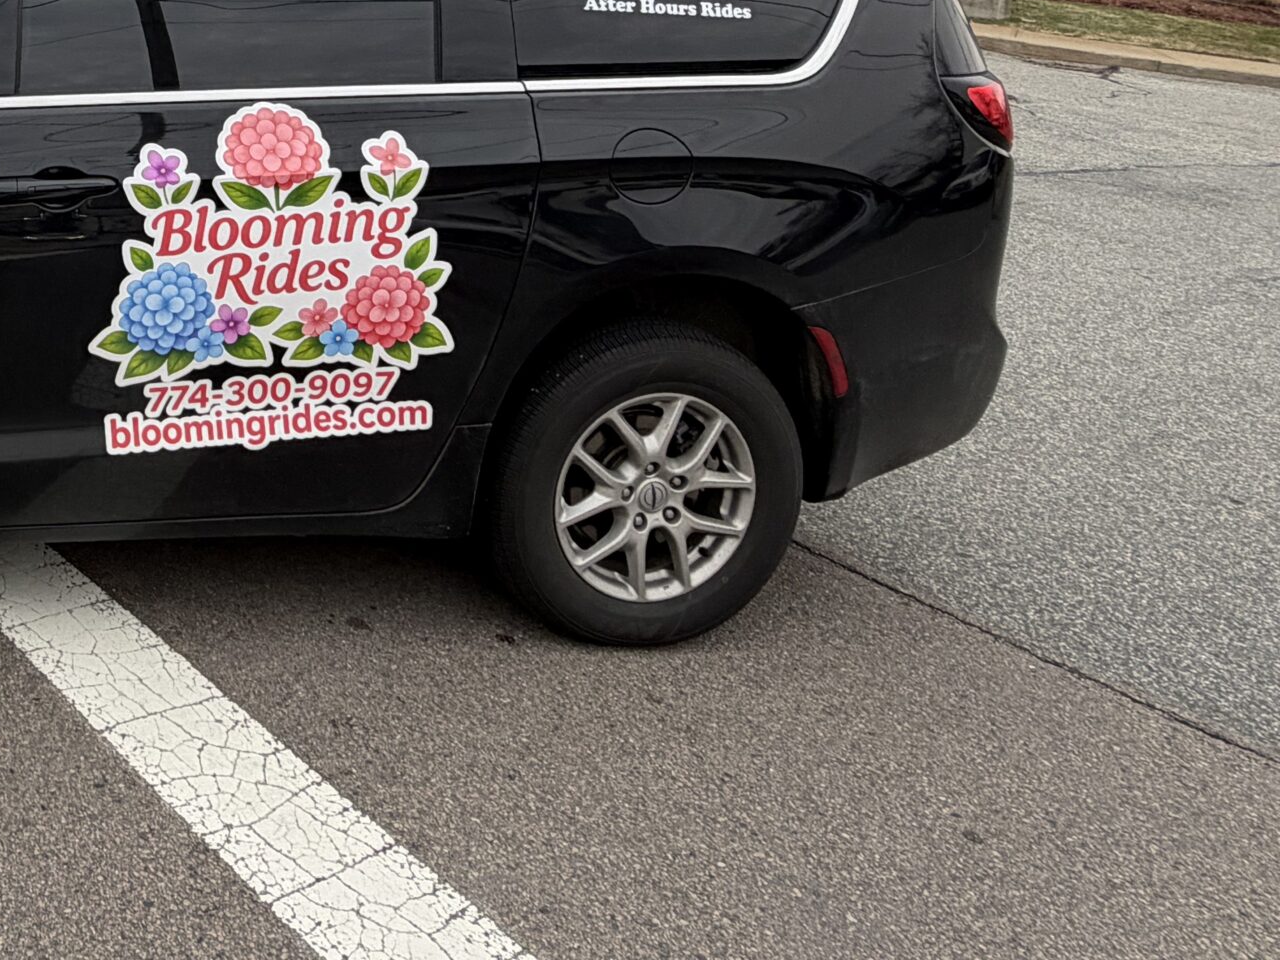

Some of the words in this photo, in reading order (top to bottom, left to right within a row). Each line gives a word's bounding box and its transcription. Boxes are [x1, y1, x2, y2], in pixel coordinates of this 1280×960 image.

[700, 1, 752, 19] Rides
[151, 198, 411, 259] Blooming
[206, 249, 350, 305] Rides
[148, 371, 396, 413] 774-300-9097
[110, 403, 428, 449] bloomingrides.com
